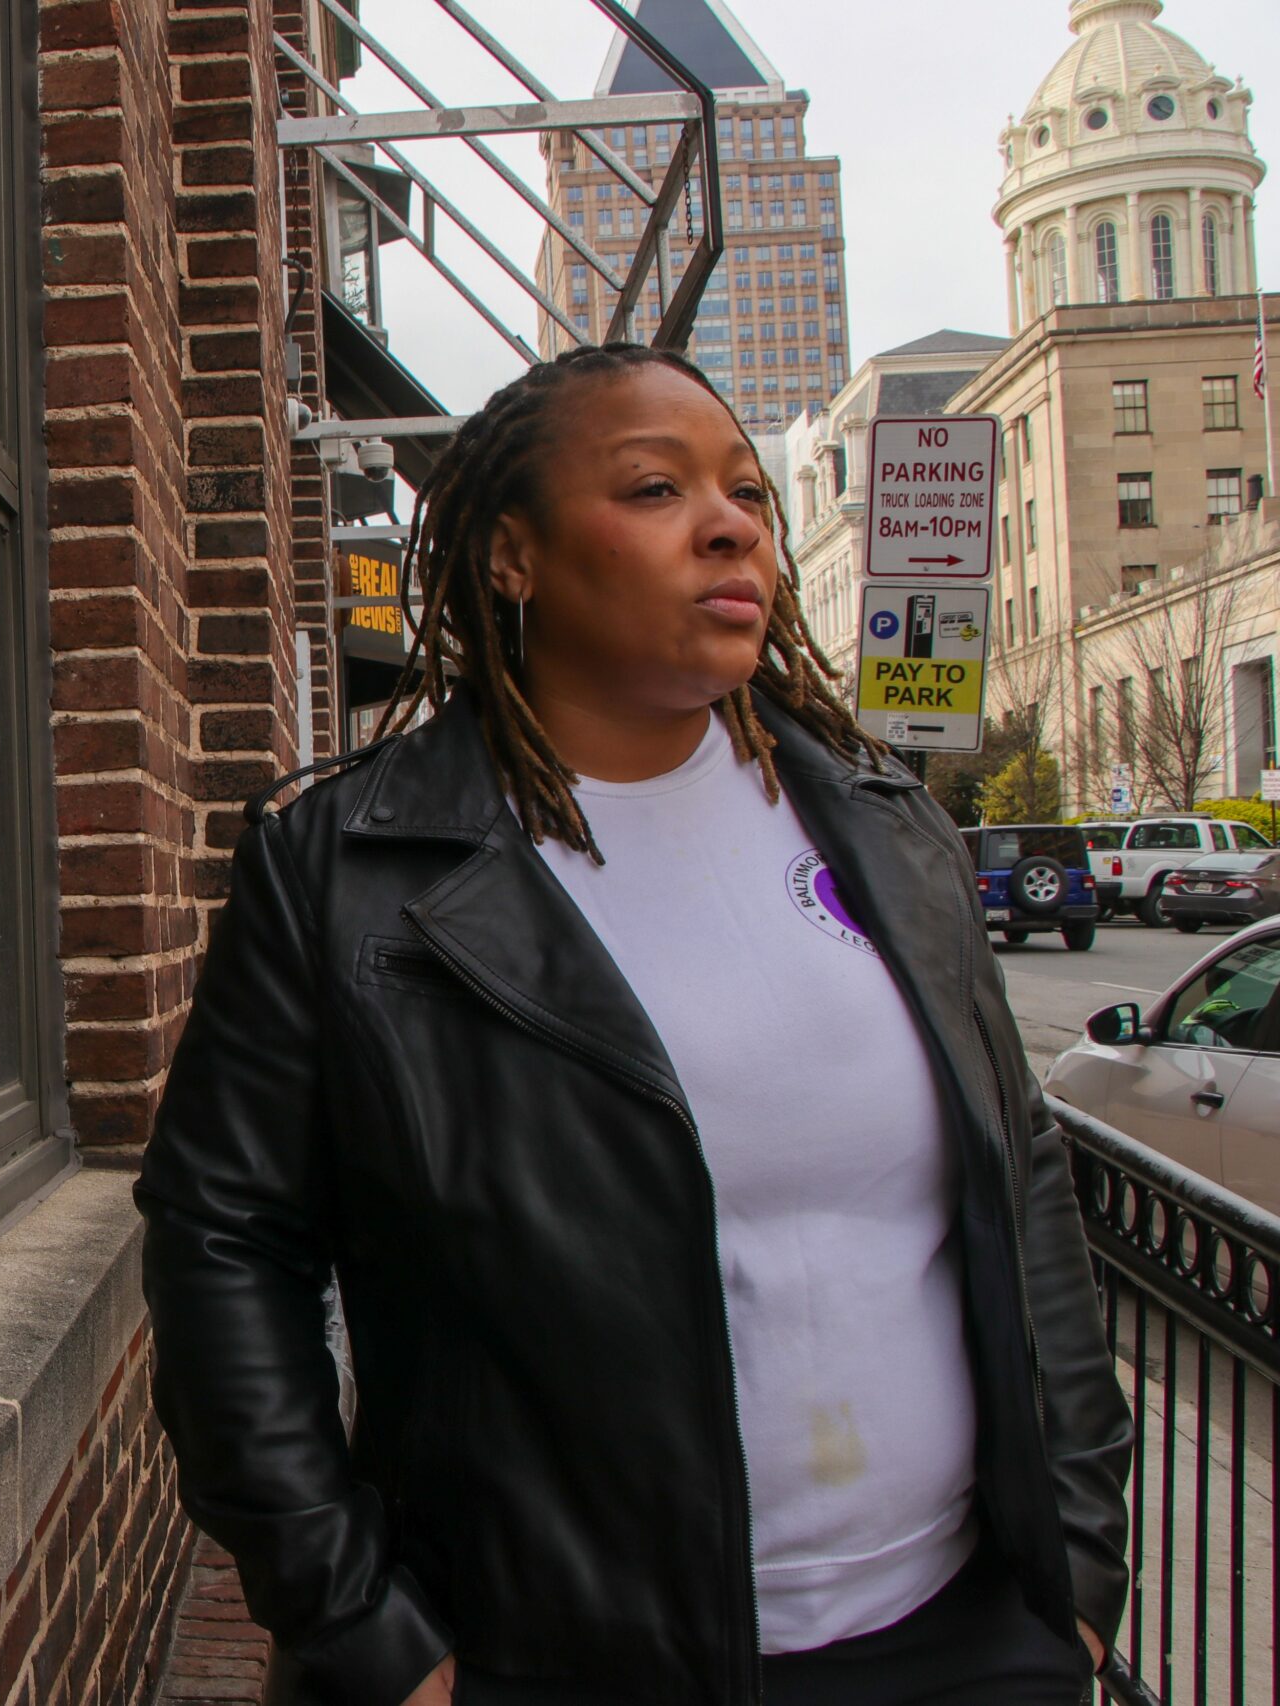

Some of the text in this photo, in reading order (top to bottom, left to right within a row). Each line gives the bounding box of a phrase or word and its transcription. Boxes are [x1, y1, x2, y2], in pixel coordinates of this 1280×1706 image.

[917, 427, 948, 447] NO
[881, 461, 985, 482] PARKING
[880, 493, 985, 508] TRUCK LOADING ZONE
[879, 516, 982, 538] 8AM-10PM
[875, 617, 892, 633] P
[875, 661, 966, 684] PAY TO
[884, 686, 953, 707] PARK
